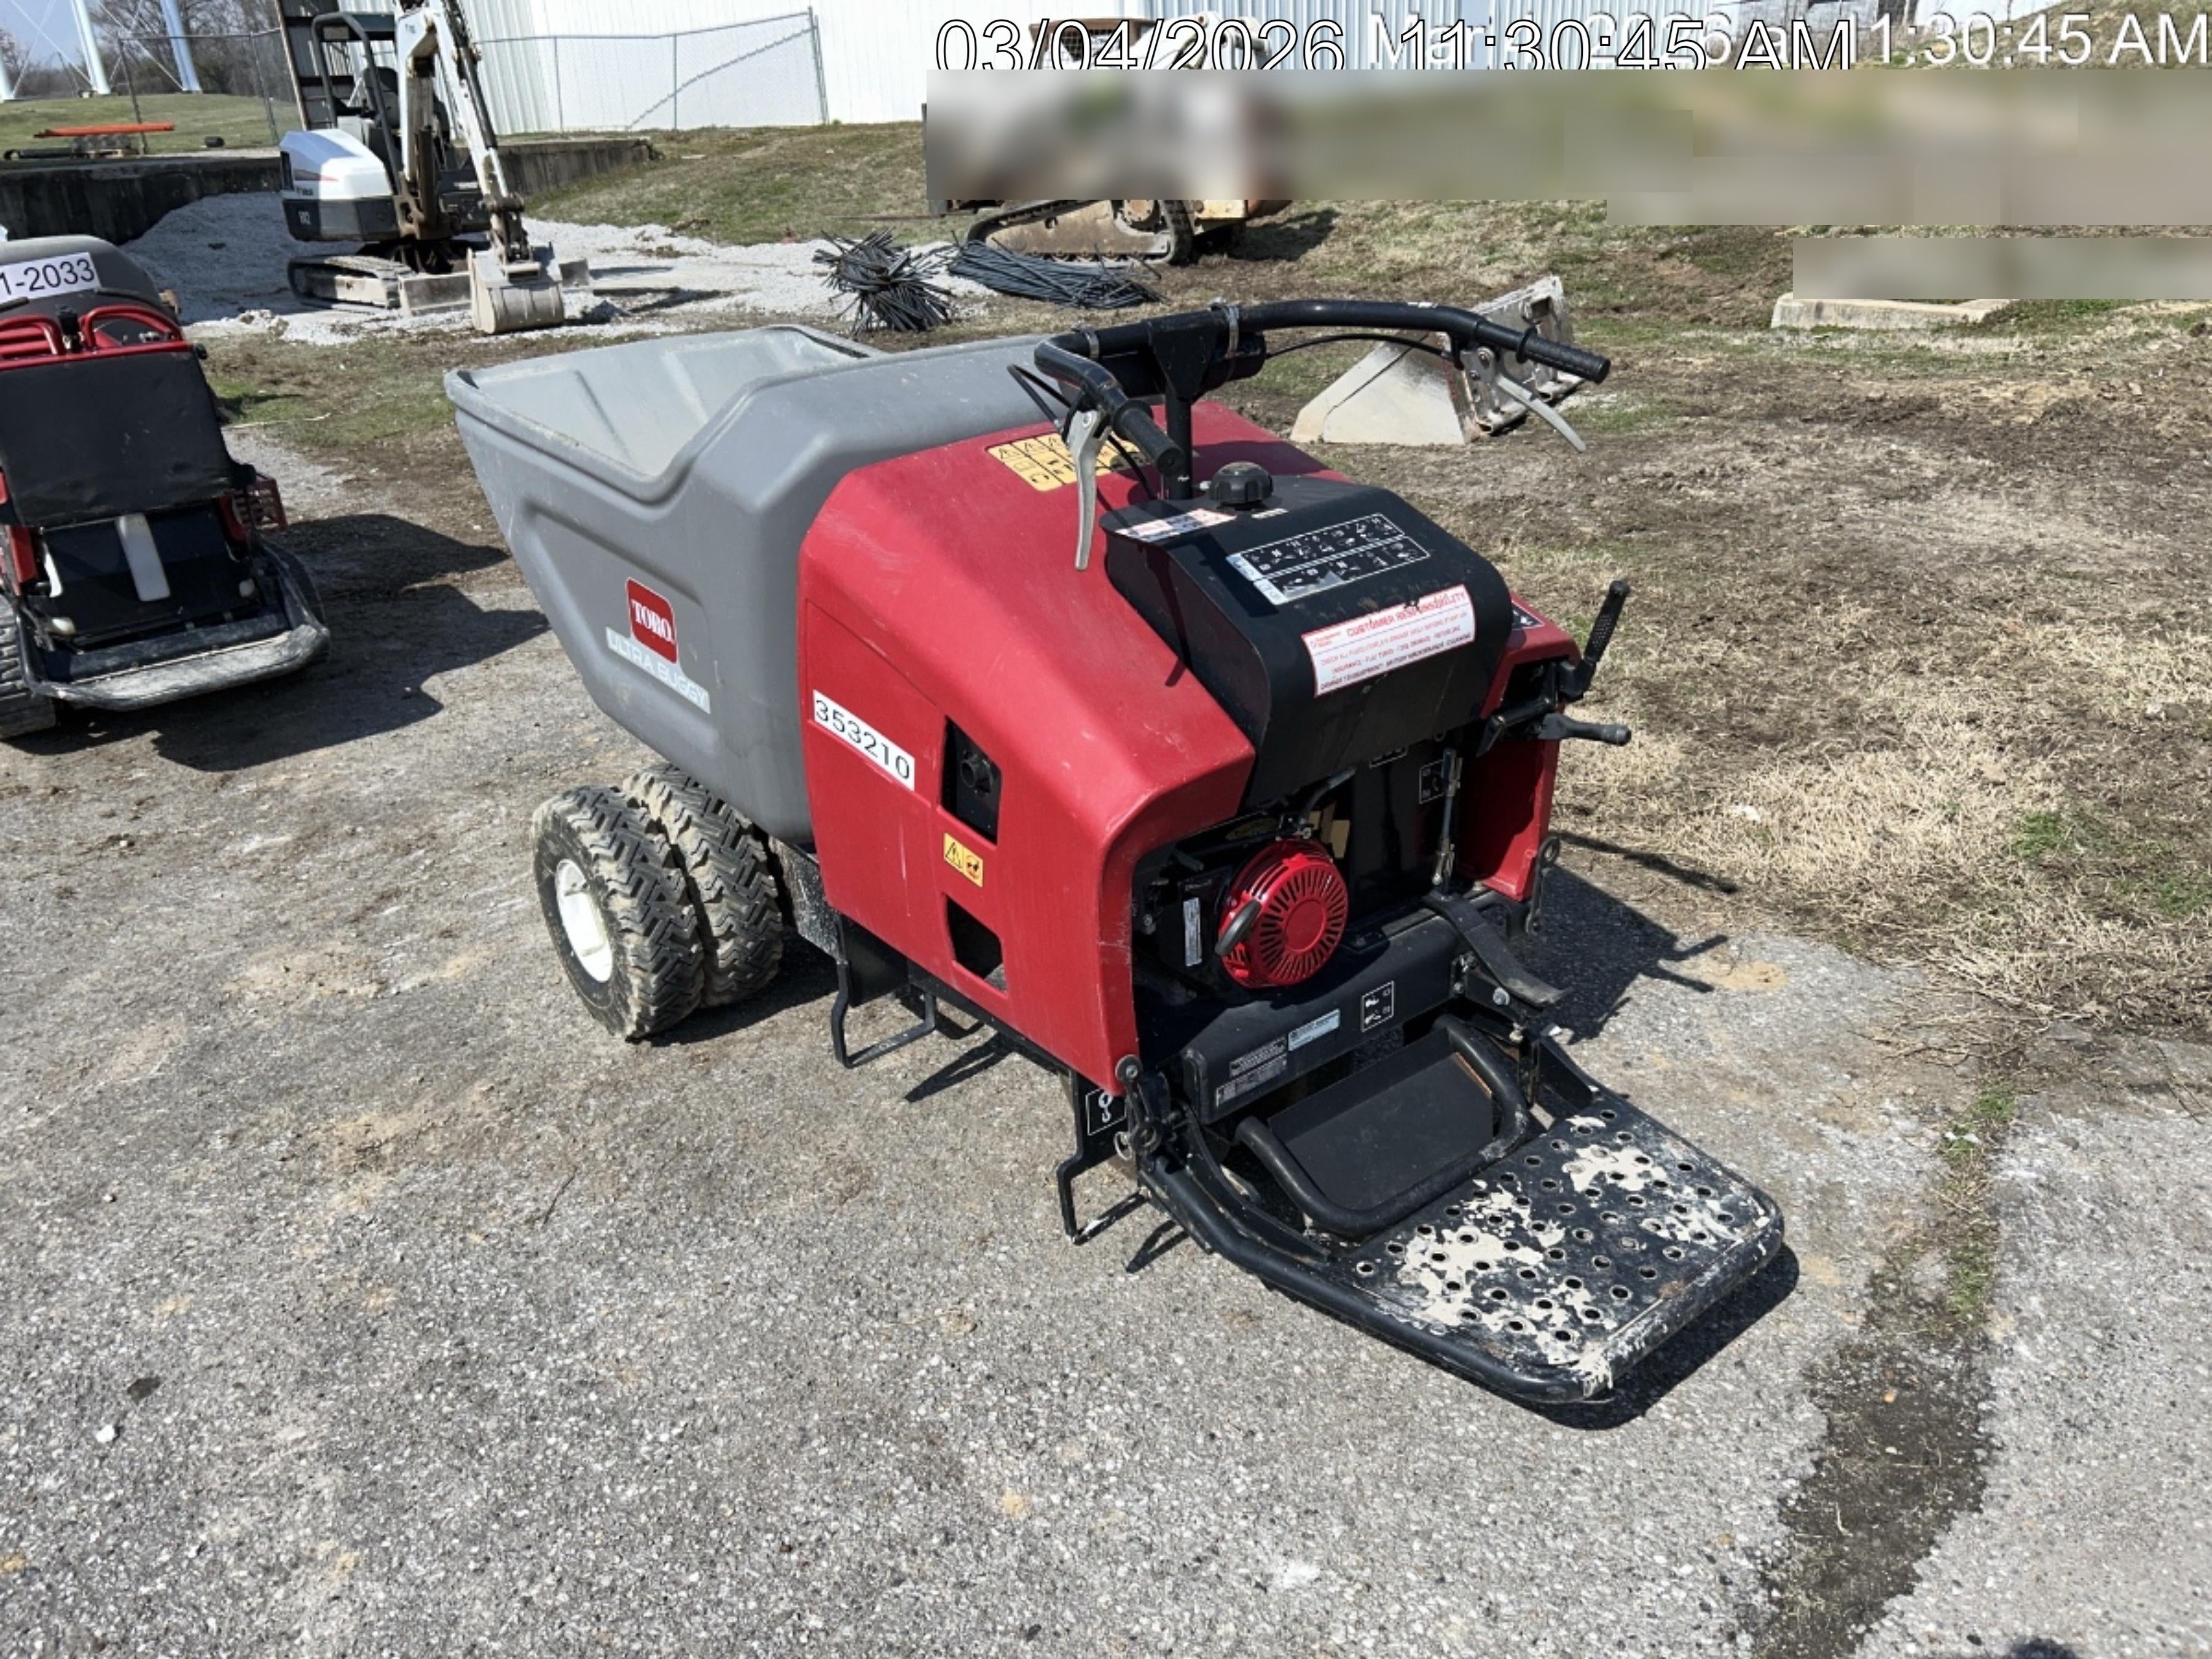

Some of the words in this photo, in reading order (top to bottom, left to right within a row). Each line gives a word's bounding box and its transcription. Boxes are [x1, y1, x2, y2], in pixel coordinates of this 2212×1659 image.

[631, 598, 675, 643] TORO
[1346, 615, 1395, 637] CUSTOMER
[607, 629, 656, 675] ULTRA
[657, 661, 707, 705] BUGGY
[815, 699, 910, 780] 353210
